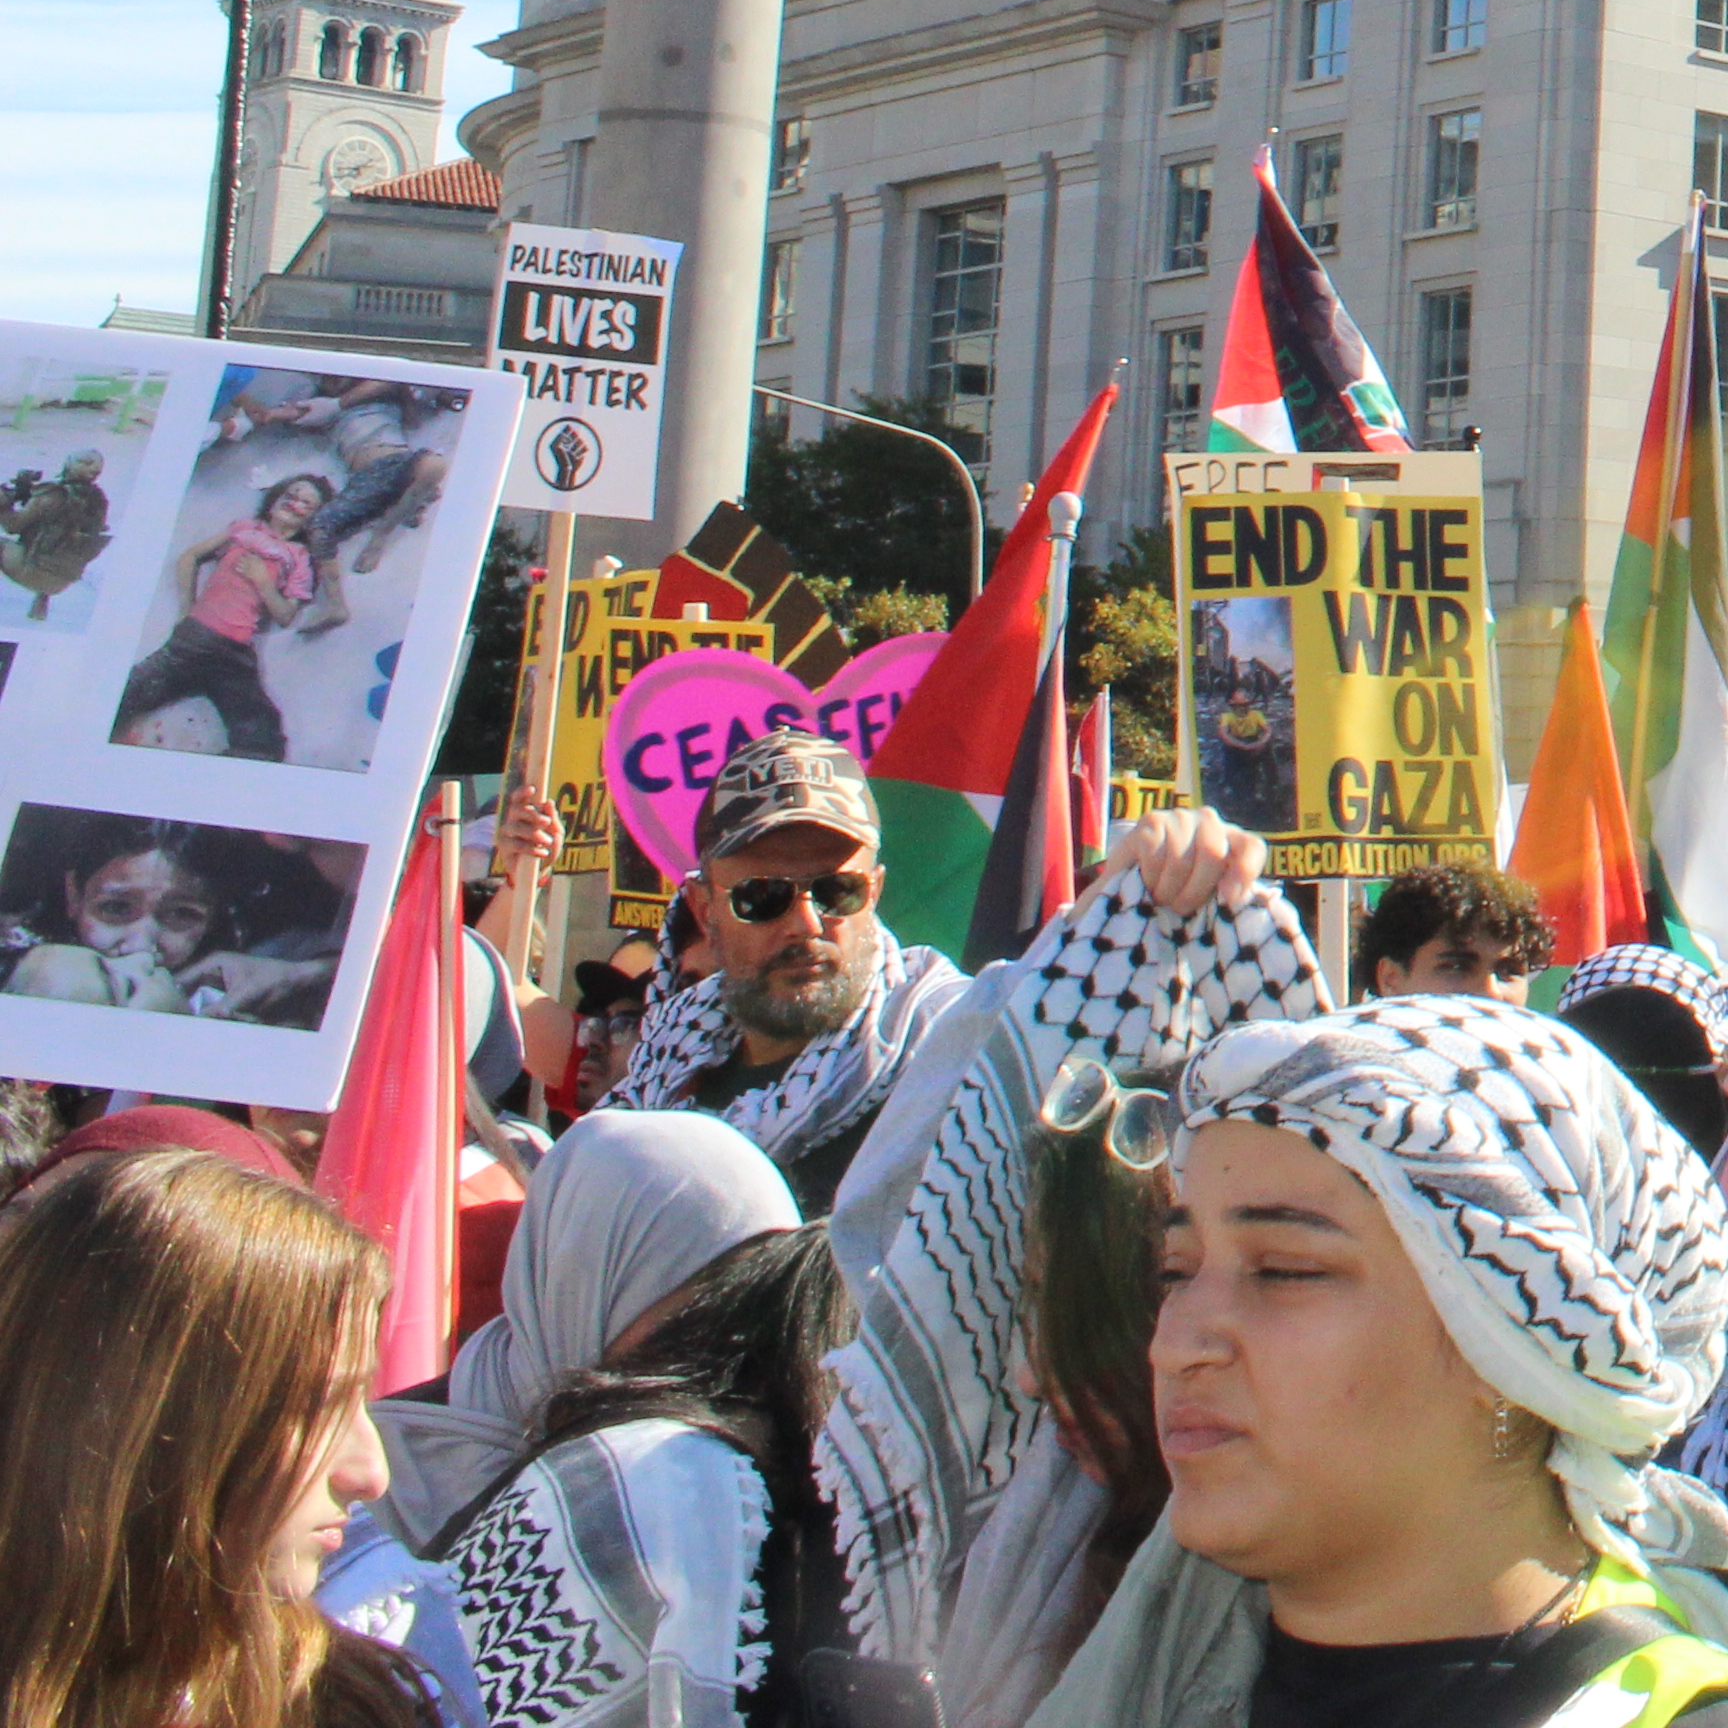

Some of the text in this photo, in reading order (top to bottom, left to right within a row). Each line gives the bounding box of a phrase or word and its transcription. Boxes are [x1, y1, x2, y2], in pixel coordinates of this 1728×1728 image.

[509, 243, 668, 287] PALESTINIAN
[522, 290, 637, 353] LIVES
[1190, 504, 1470, 592] END THE
[1322, 590, 1474, 678] WAR
[1393, 681, 1480, 757] ON
[749, 756, 828, 783] YETI
[1327, 756, 1486, 835] GAZA
